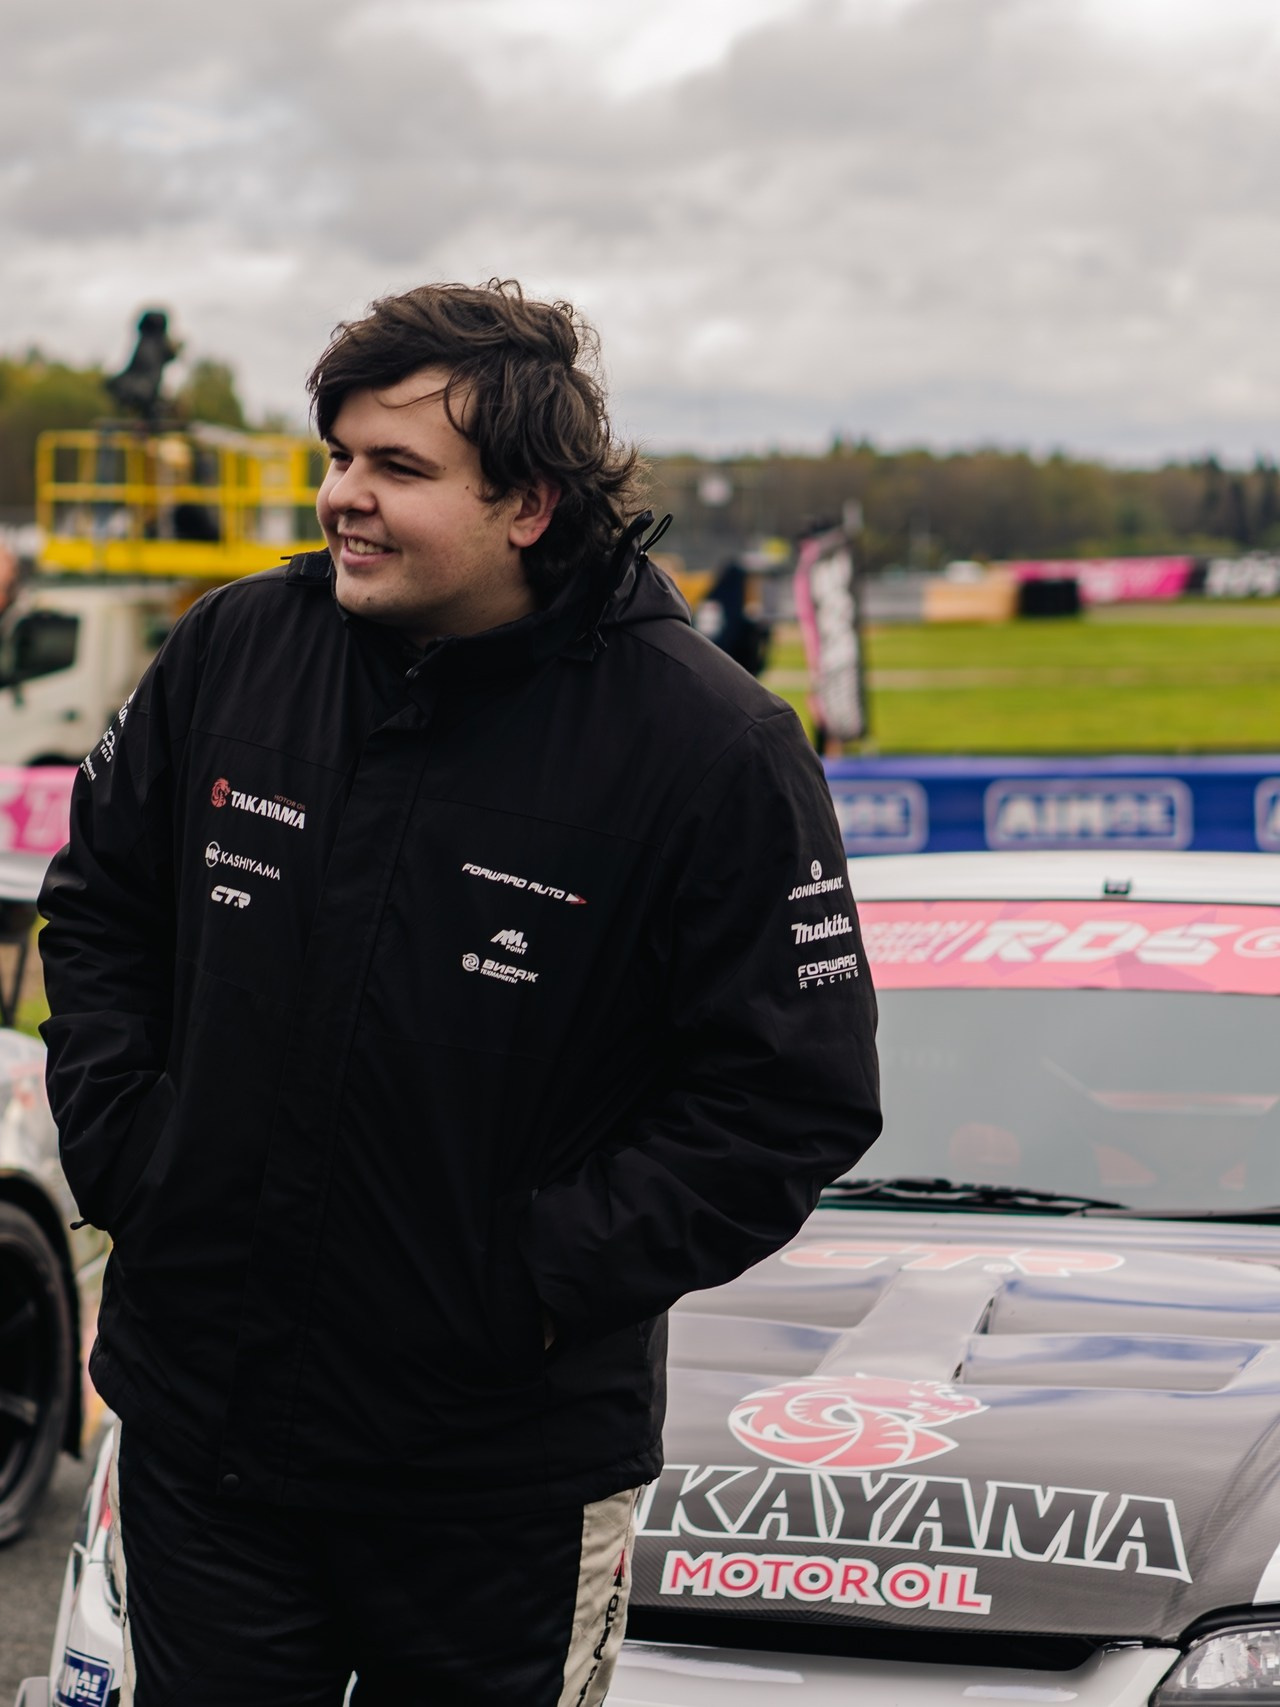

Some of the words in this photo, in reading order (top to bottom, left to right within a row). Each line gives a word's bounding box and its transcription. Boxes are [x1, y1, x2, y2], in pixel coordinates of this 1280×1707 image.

[231, 790, 306, 829] TAKAYAMA
[220, 851, 280, 880] KASHIYAMA
[462, 863, 527, 888] FORWARD
[528, 882, 565, 899] AUTO
[505, 943, 527, 955] POINT
[961, 920, 1244, 965] RDS
[482, 959, 539, 983] ВИРАЖ
[798, 953, 857, 978] FORWARD
[799, 969, 859, 990] RACING
[634, 1464, 1193, 1583] KAYAMA
[659, 1551, 884, 1606] MOTOR
[884, 1561, 993, 1614] OIL
